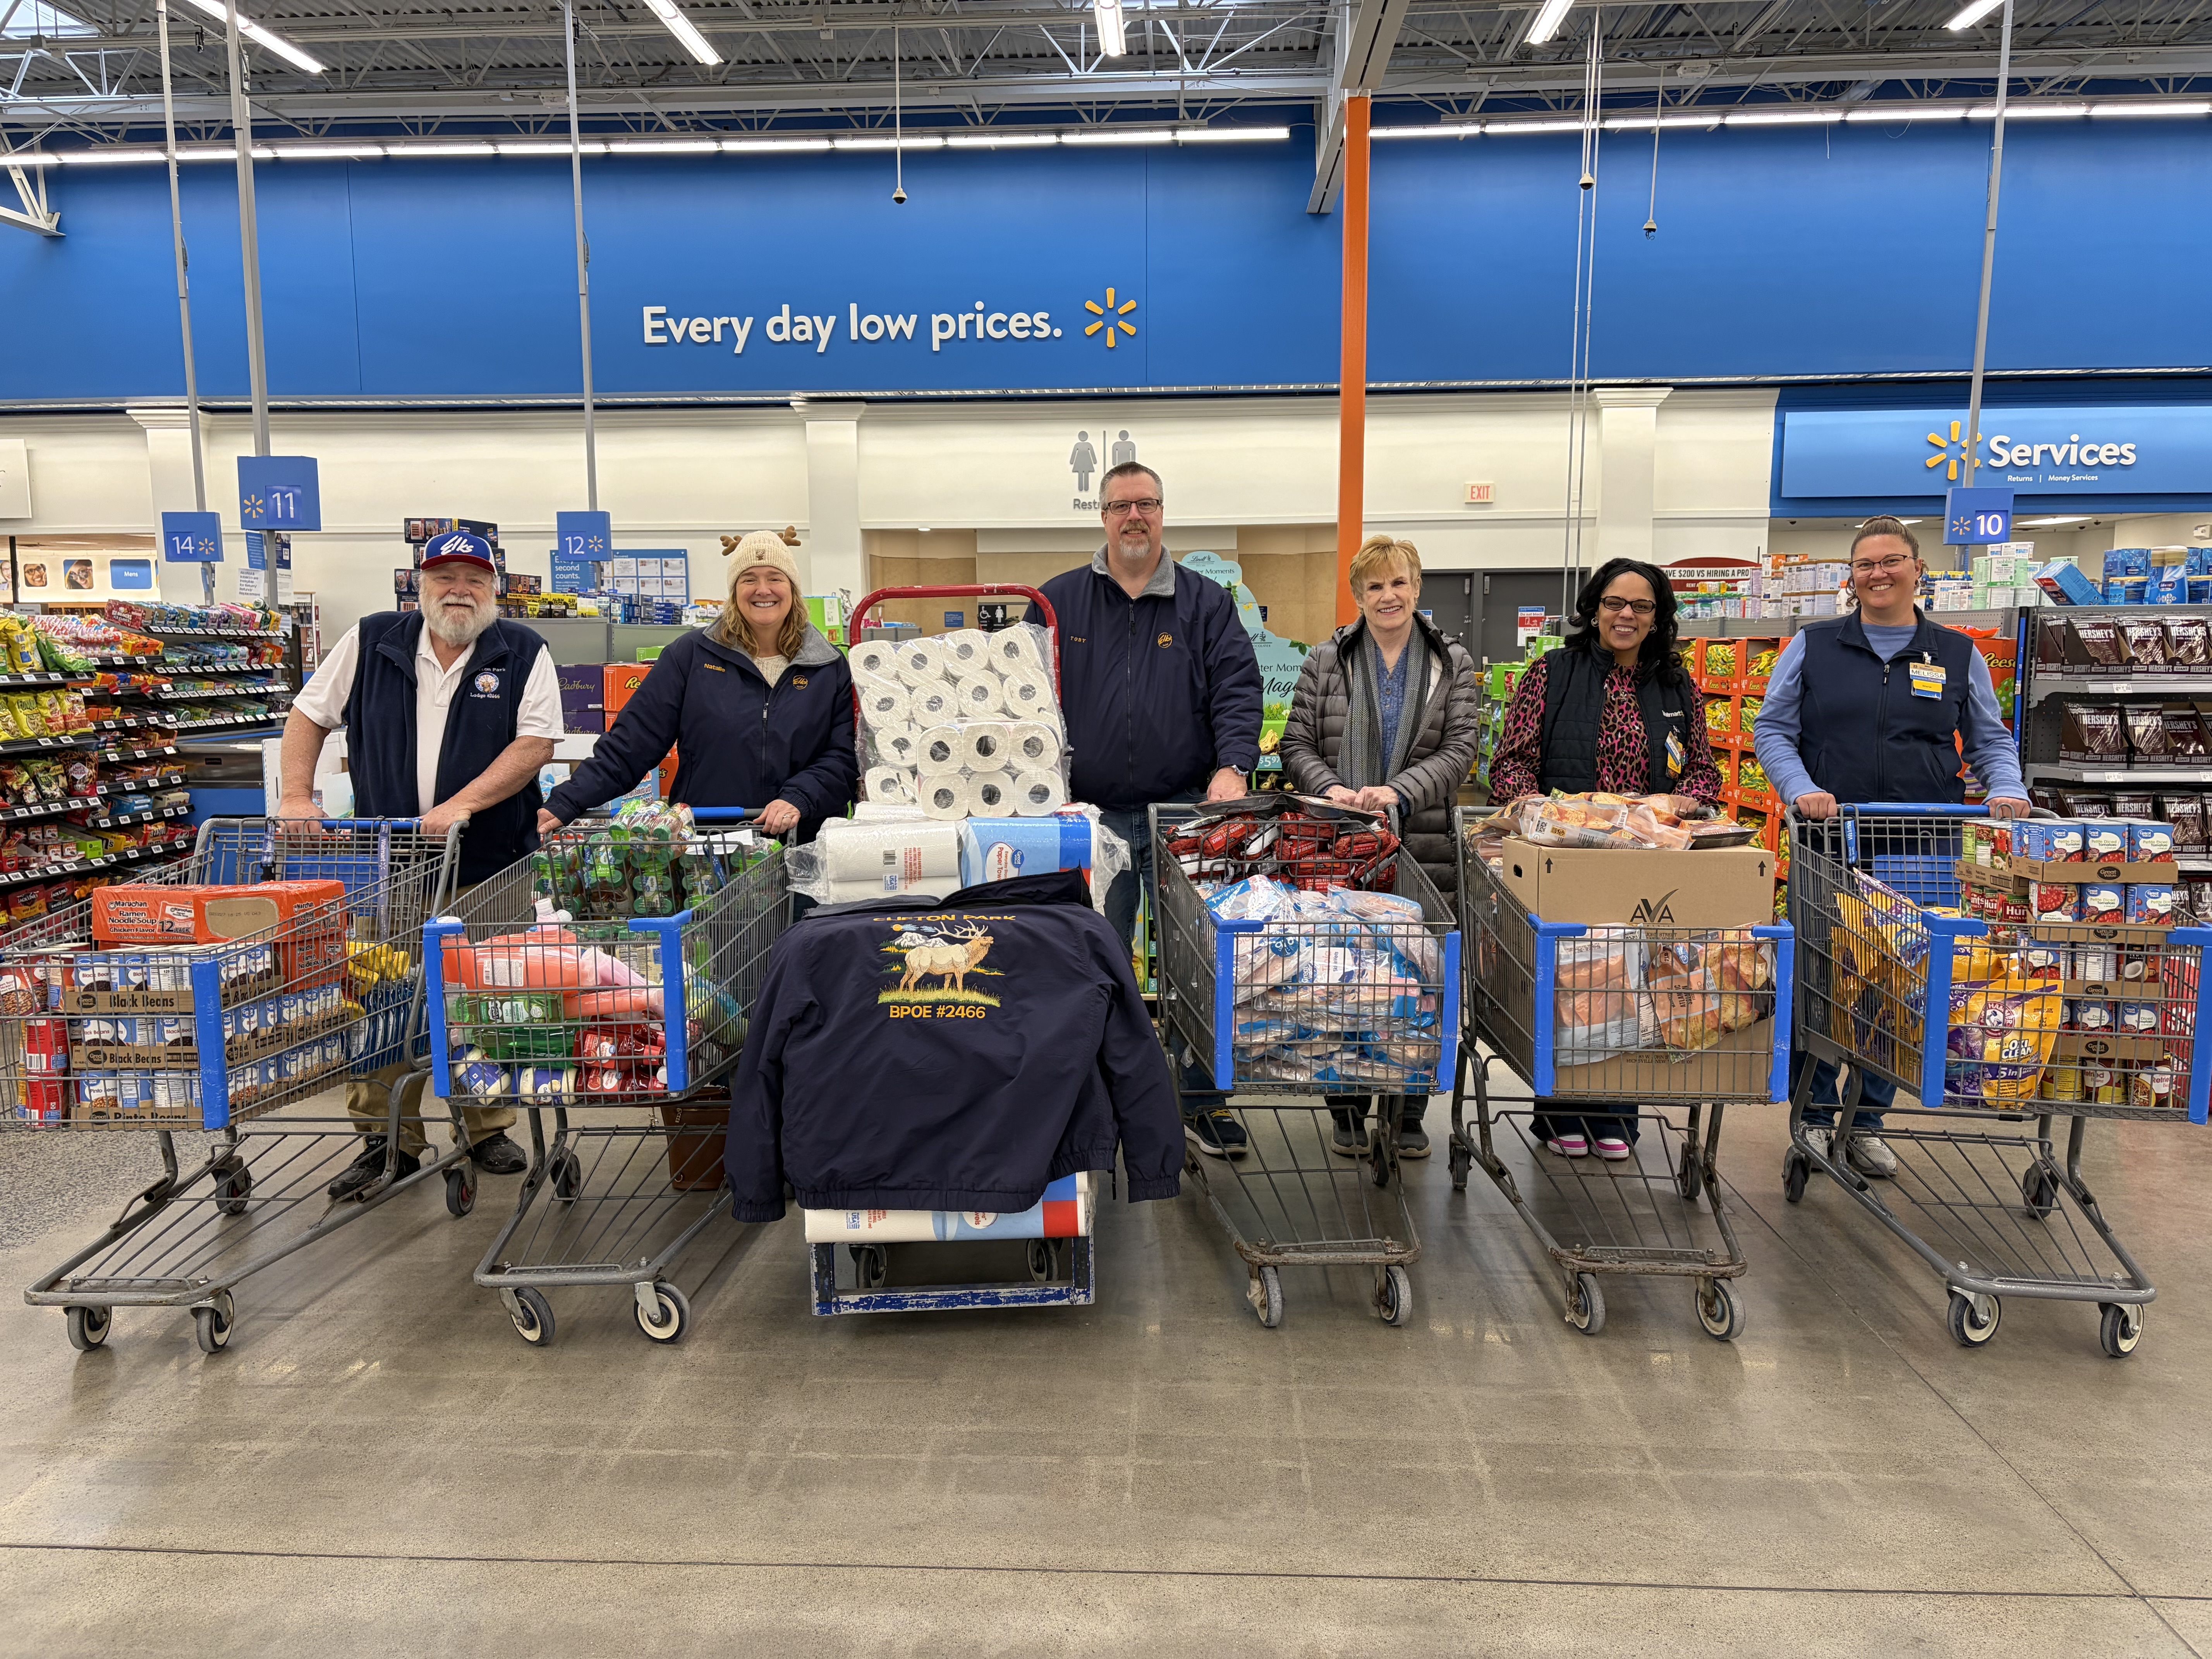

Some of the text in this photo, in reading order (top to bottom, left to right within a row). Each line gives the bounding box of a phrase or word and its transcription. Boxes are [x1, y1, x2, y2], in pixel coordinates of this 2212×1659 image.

[643, 301, 1062, 354] Every day low prices.
[1988, 433, 2136, 468] Services
[2007, 473, 2098, 484] Returns Money Services
[1470, 485, 1490, 500] EXIT
[272, 492, 294, 519] 11
[1073, 498, 1100, 509] Restr
[1977, 514, 2003, 537] 10
[172, 536, 195, 555] 14
[440, 535, 474, 555] Elks
[565, 536, 584, 554] 12
[555, 563, 579, 571] second
[1665, 569, 1676, 577] AVE
[1678, 569, 1695, 577] $200
[1697, 569, 1705, 577] VS
[1707, 569, 1729, 577] HIRING
[1737, 568, 1749, 577] PRO
[2080, 629, 2114, 639] HERSHEY'S
[2127, 627, 2162, 637] HERSHEY'S
[2171, 626, 2207, 637] HERSHEY'S
[704, 663, 726, 673] Natalie
[1911, 669, 1945, 679] MELISSA
[558, 678, 595, 692] Cadbury
[2082, 715, 2118, 725] HERSHEY'S
[2128, 716, 2162, 725] HERSHEY'S
[2075, 804, 2110, 814] HERSHEY'S
[2116, 803, 2151, 813] HERSHEY'S
[2166, 803, 2202, 813] HERSHEY'S
[1971, 895, 1984, 904] unt's
[1630, 889, 1679, 923] AVA
[136, 917, 157, 926] Soup
[159, 920, 175, 933] 12
[110, 994, 175, 1008] Black Beans
[890, 1005, 986, 1019] BPOE #2466
[2009, 1039, 2029, 1050] OXI
[110, 1053, 132, 1063] Back
[2002, 1045, 2033, 1060] CLEAN
